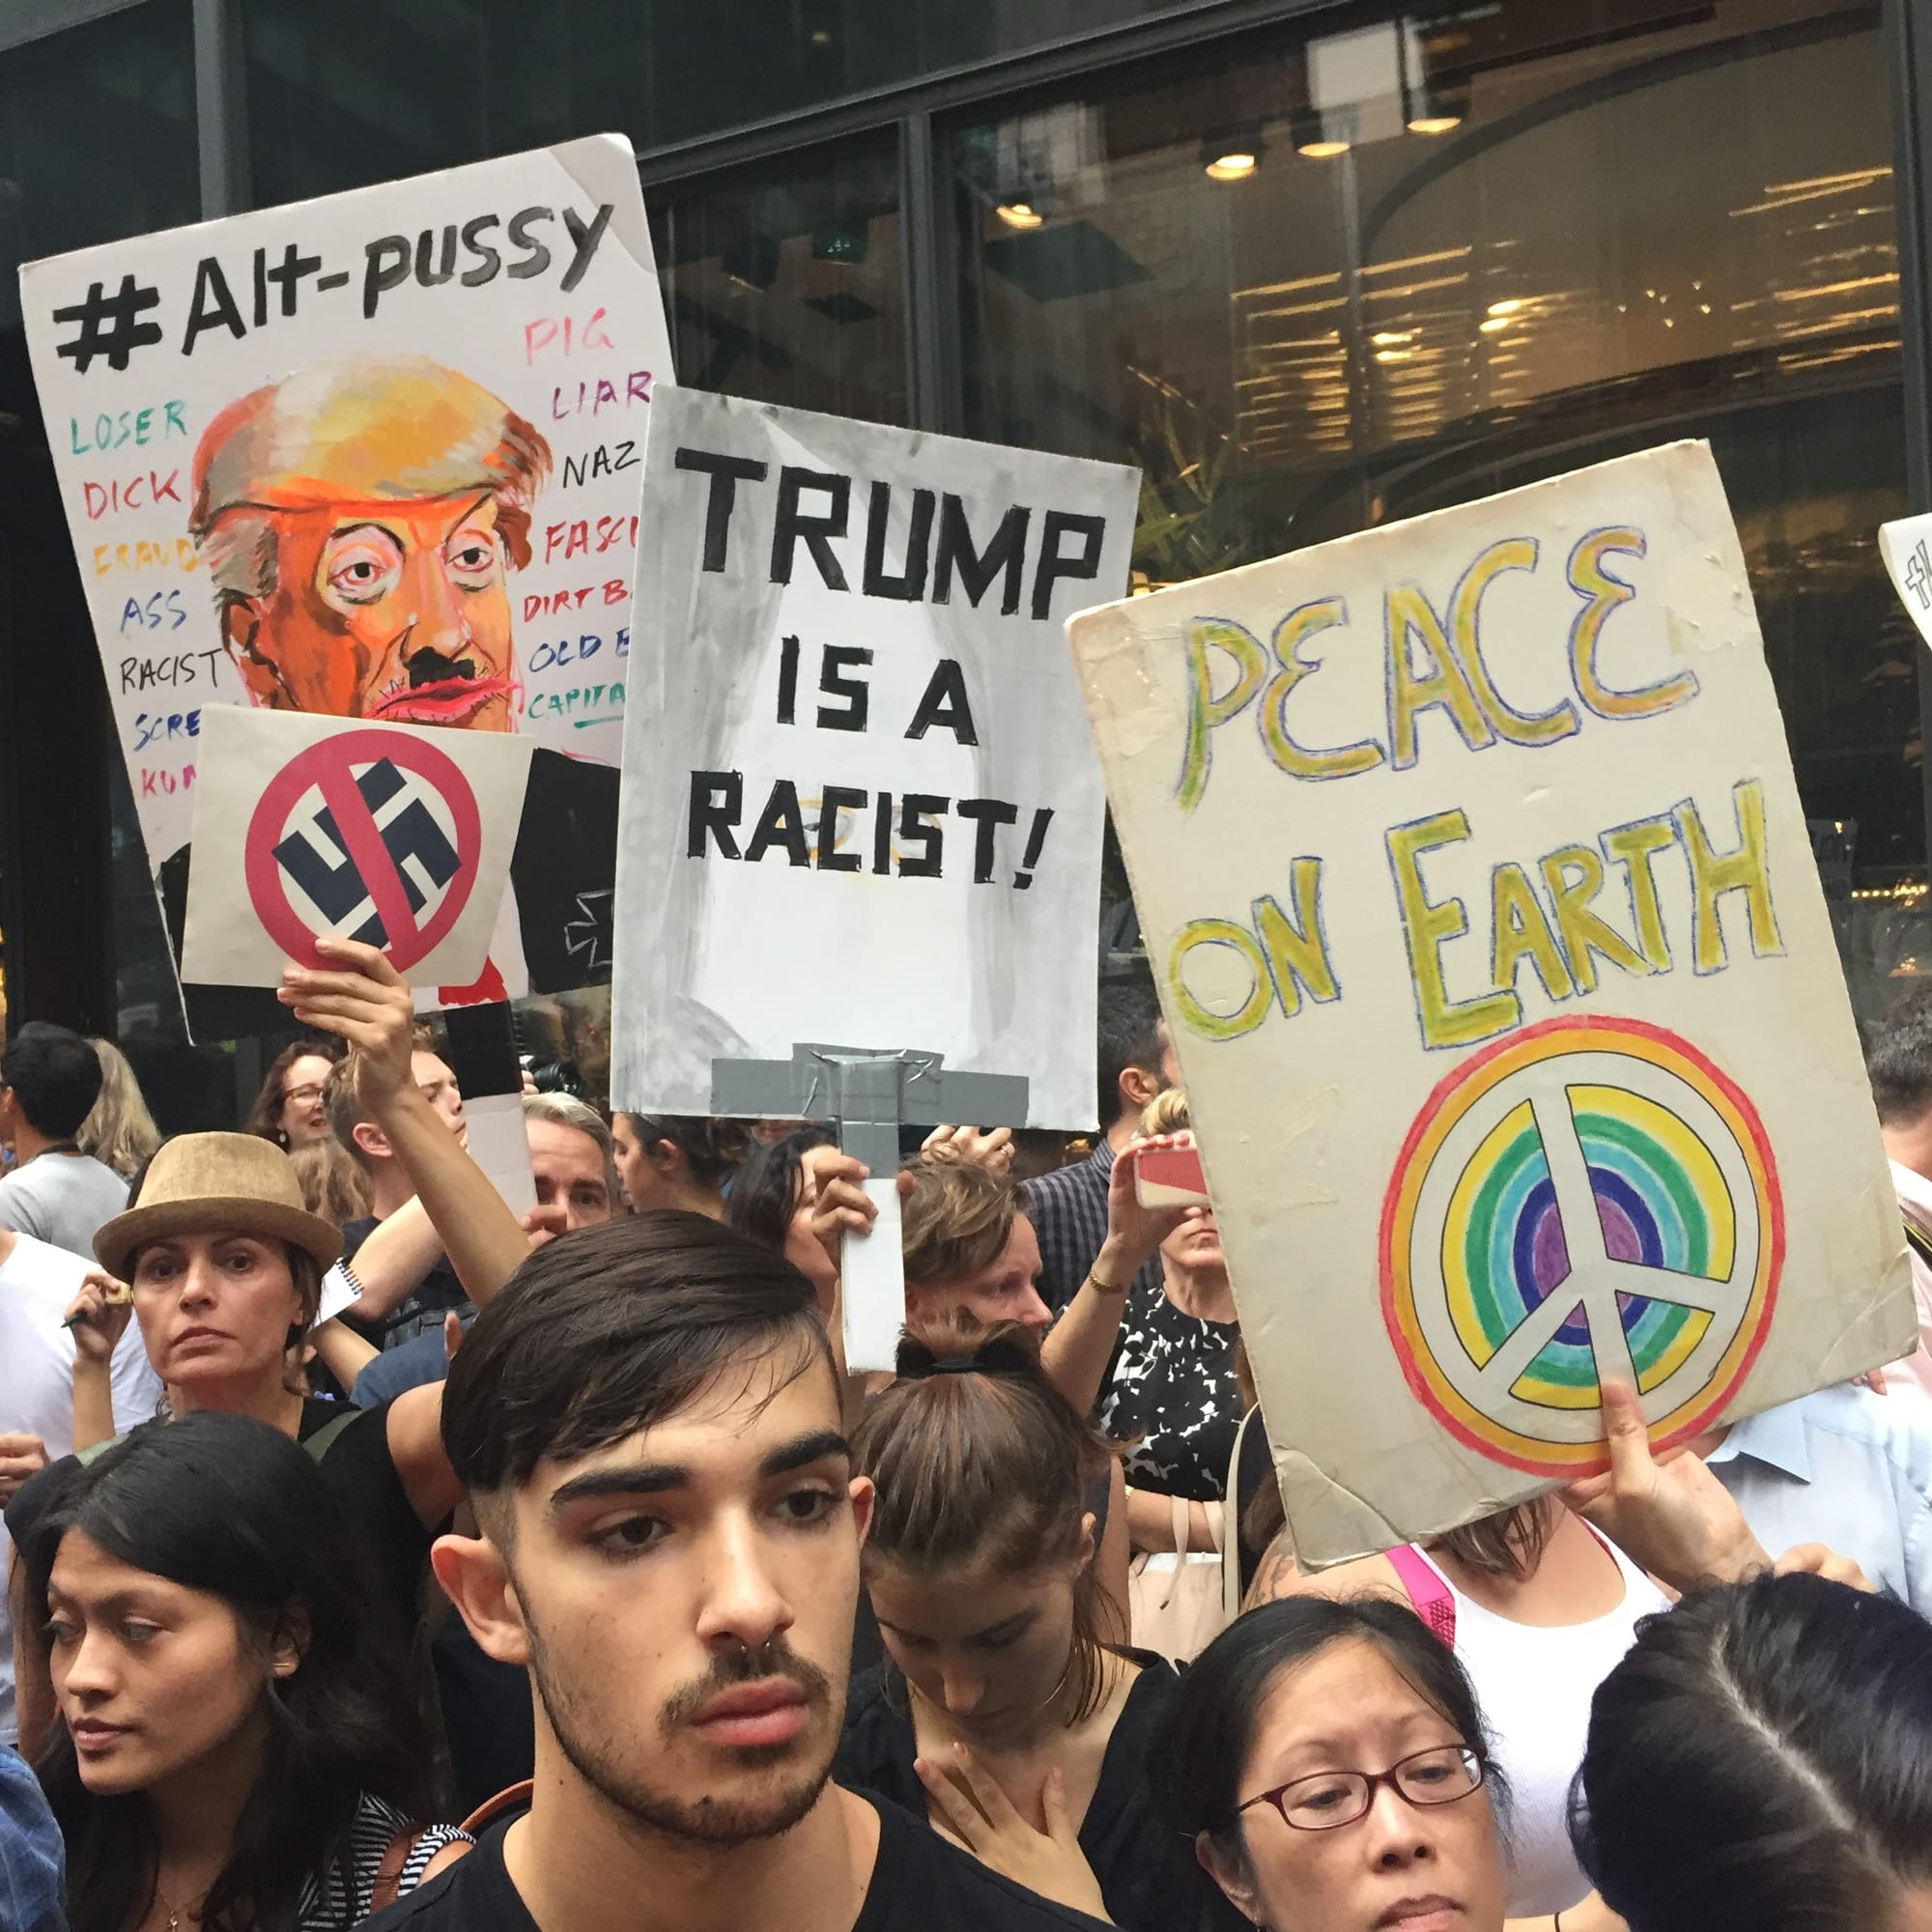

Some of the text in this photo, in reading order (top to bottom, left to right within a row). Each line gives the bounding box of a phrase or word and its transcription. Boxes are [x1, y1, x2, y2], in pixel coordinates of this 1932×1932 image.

[525, 307, 614, 366] PIG
[553, 371, 652, 420] LIAR
[71, 399, 187, 455] LOSER
[83, 469, 182, 520] DICK
[675, 447, 1106, 620] TRUMP
[120, 589, 186, 634] ASS
[524, 579, 634, 623] DIRT B
[120, 648, 223, 695] RACIST
[529, 635, 602, 672] OLD
[1172, 525, 1701, 813] PEACE
[777, 635, 979, 746] IS A
[687, 769, 1056, 890] RACIST!
[1168, 856, 1342, 1042] ON
